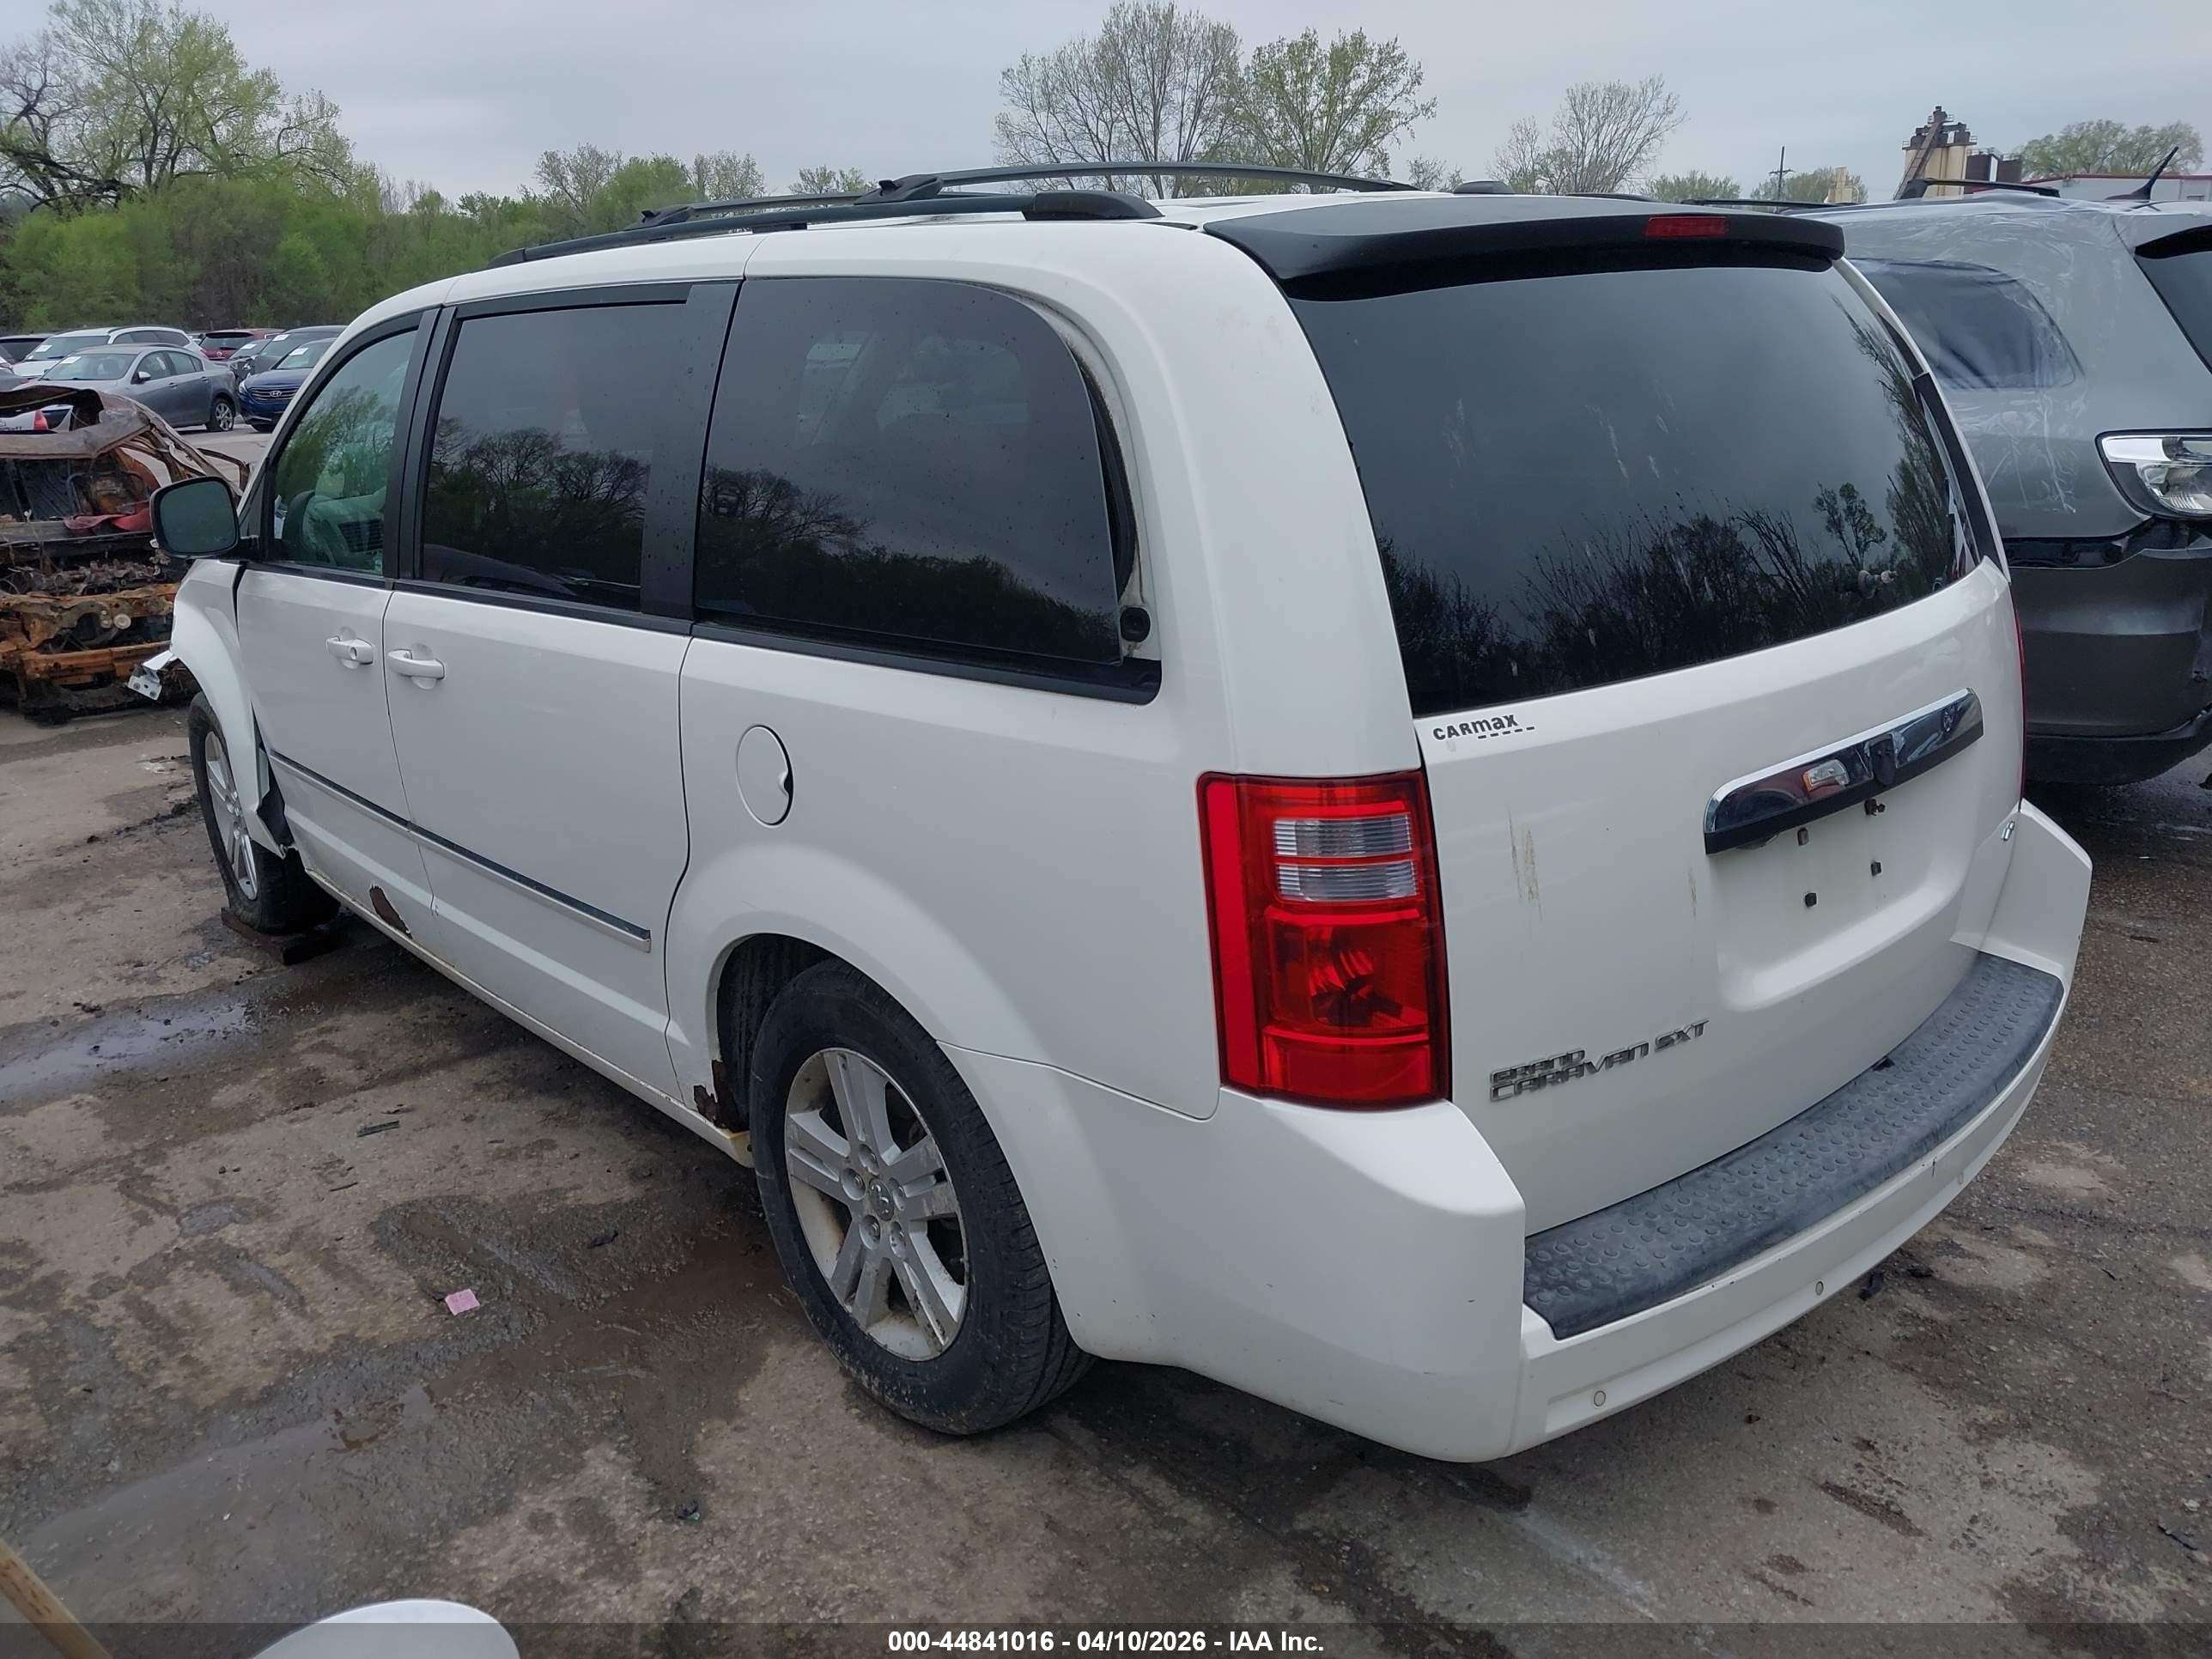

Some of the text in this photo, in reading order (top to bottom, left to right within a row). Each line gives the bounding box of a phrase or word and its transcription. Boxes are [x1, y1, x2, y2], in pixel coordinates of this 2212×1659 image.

[1490, 1018, 1710, 1102] CARAVAN SXT
[1490, 1047, 1586, 1085] GRAND
